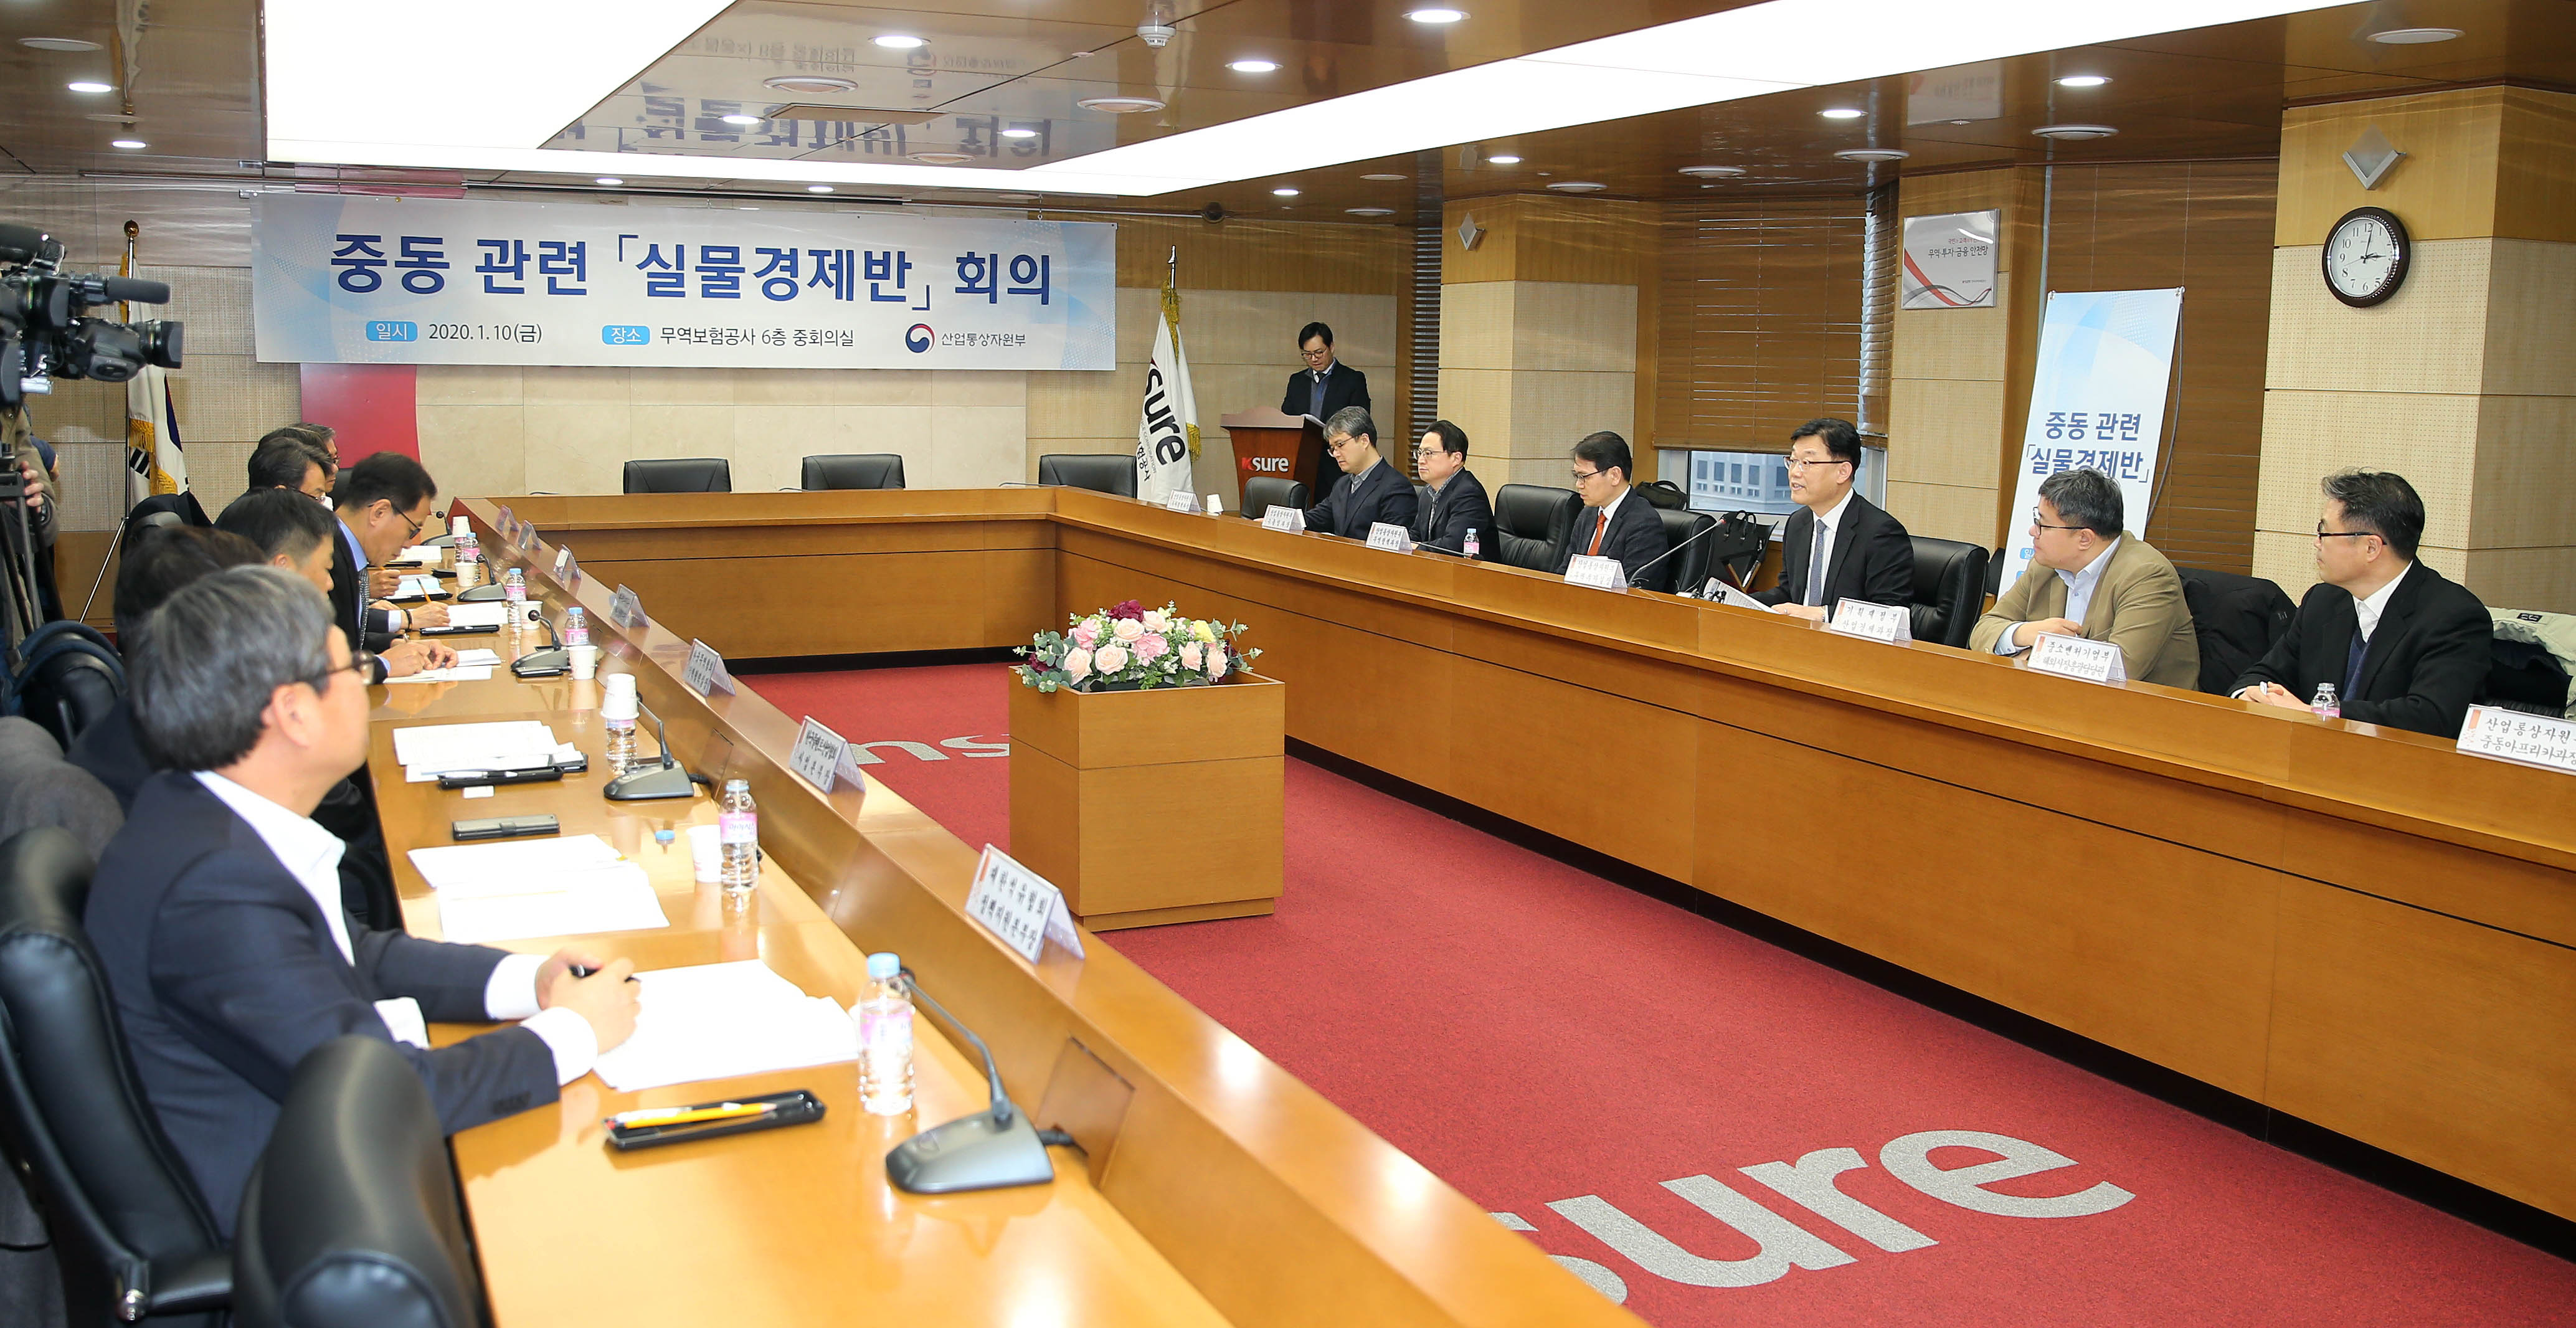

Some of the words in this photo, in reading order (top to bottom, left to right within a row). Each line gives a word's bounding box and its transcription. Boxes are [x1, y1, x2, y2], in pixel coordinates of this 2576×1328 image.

[1970, 245, 1988, 256] 안전망
[330, 234, 450, 294] 중동
[475, 239, 587, 296] 관련
[618, 234, 931, 311] 「실물경제반」
[954, 250, 1051, 305] 회의
[375, 322, 409, 341] 일시
[429, 323, 543, 344] 2020.1.10(금)
[610, 326, 643, 344] 장소
[659, 326, 755, 346] 무역보험공사
[761, 329, 787, 346] 6층
[792, 328, 855, 347] 중회의실
[941, 332, 1027, 348] 산업통상자원부
[1144, 366, 1186, 466] sure
[2045, 412, 2088, 440] 중동
[2095, 412, 2143, 442] 관련
[1846, 605, 1898, 624] 기획재정부
[2047, 640, 2110, 663] 중소벤처기업부
[2486, 717, 2576, 744] 산업통상자원
